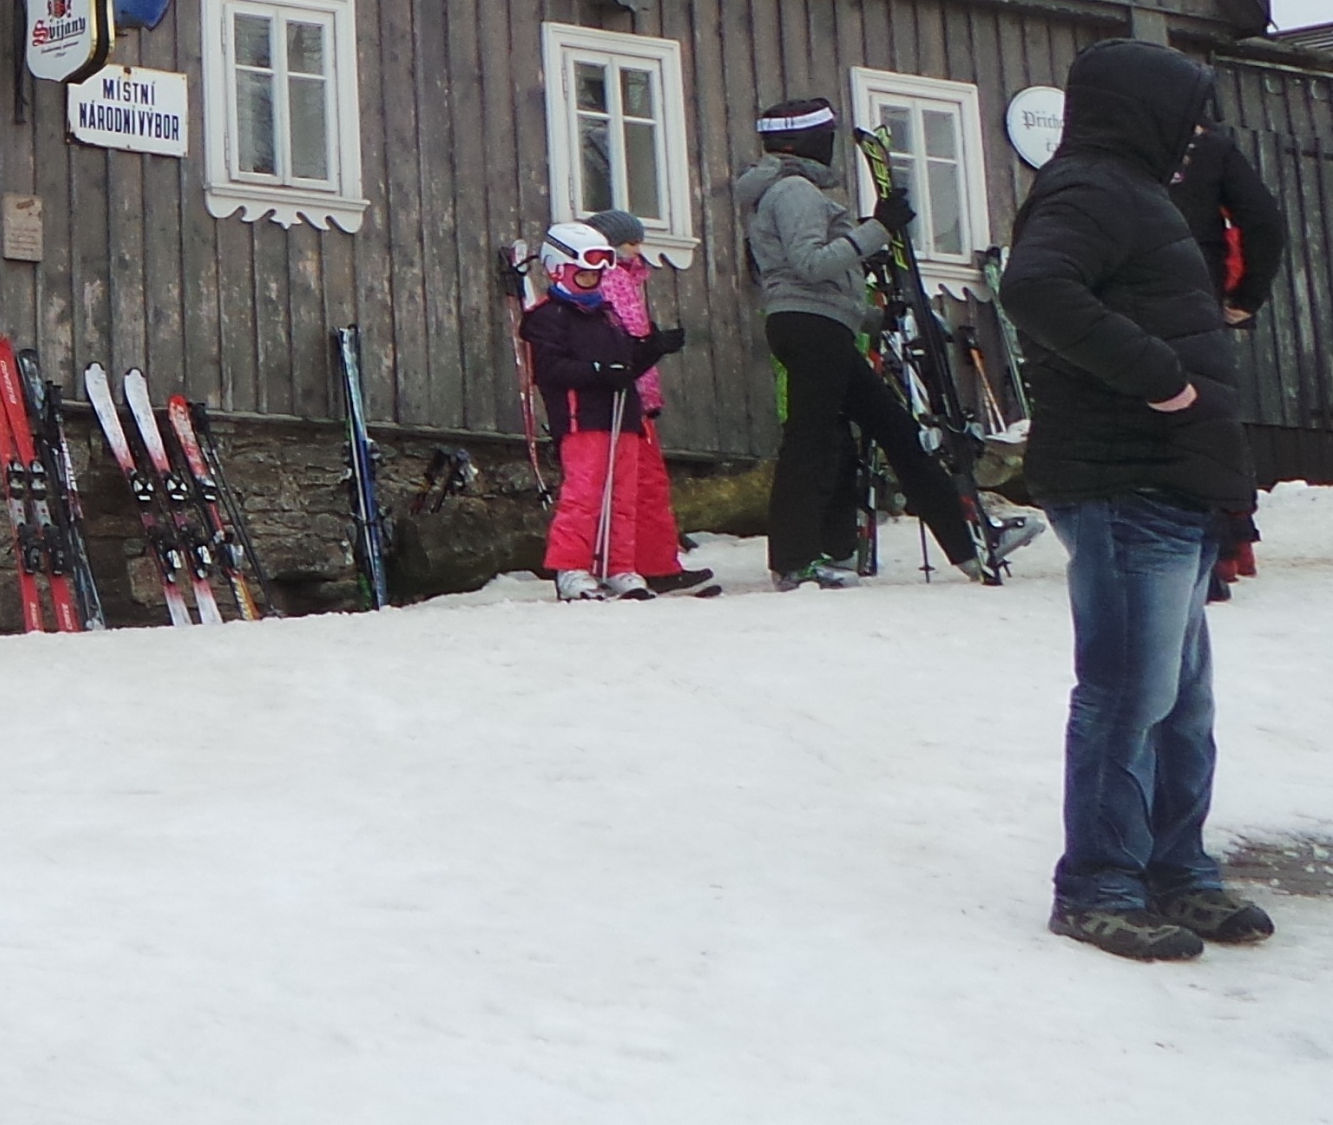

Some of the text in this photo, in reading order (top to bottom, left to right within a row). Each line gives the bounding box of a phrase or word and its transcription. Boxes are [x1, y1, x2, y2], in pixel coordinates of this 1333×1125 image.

[32, 17, 86, 46] Svijany
[103, 76, 155, 105] MÍSTNÍ
[79, 100, 179, 141] NÁRODNÍ VÝBOR
